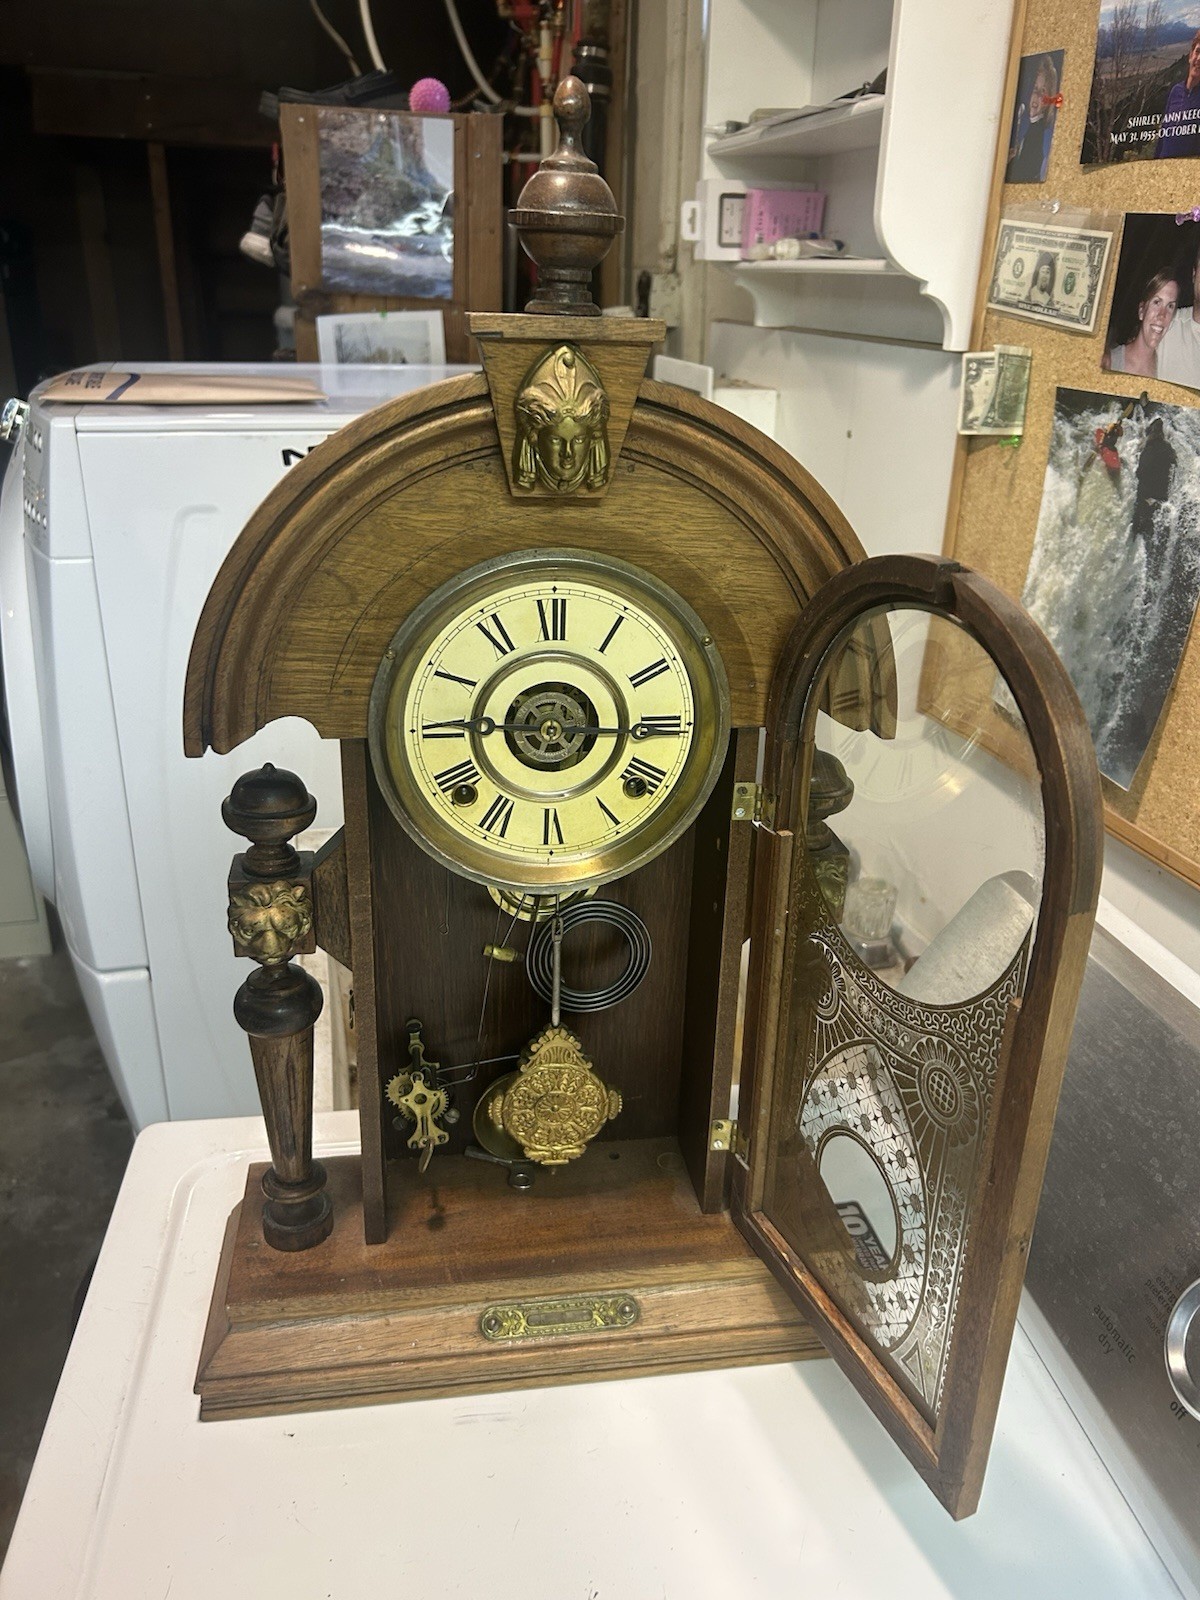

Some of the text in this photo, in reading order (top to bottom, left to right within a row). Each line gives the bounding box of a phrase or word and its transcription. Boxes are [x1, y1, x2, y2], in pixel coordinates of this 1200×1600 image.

[1127, 113, 1162, 129] SHIRLEY
[1163, 110, 1181, 123] ANN
[1110, 131, 1128, 145] MAY
[533, 598, 572, 643] XII
[431, 660, 480, 698] X
[538, 806, 567, 846] VI
[836, 1203, 869, 1236] 10
[1144, 1279, 1173, 1314] preferre
[1093, 1304, 1137, 1364] automatic
[1097, 1331, 1116, 1356] dry
[1169, 1400, 1188, 1421] off
